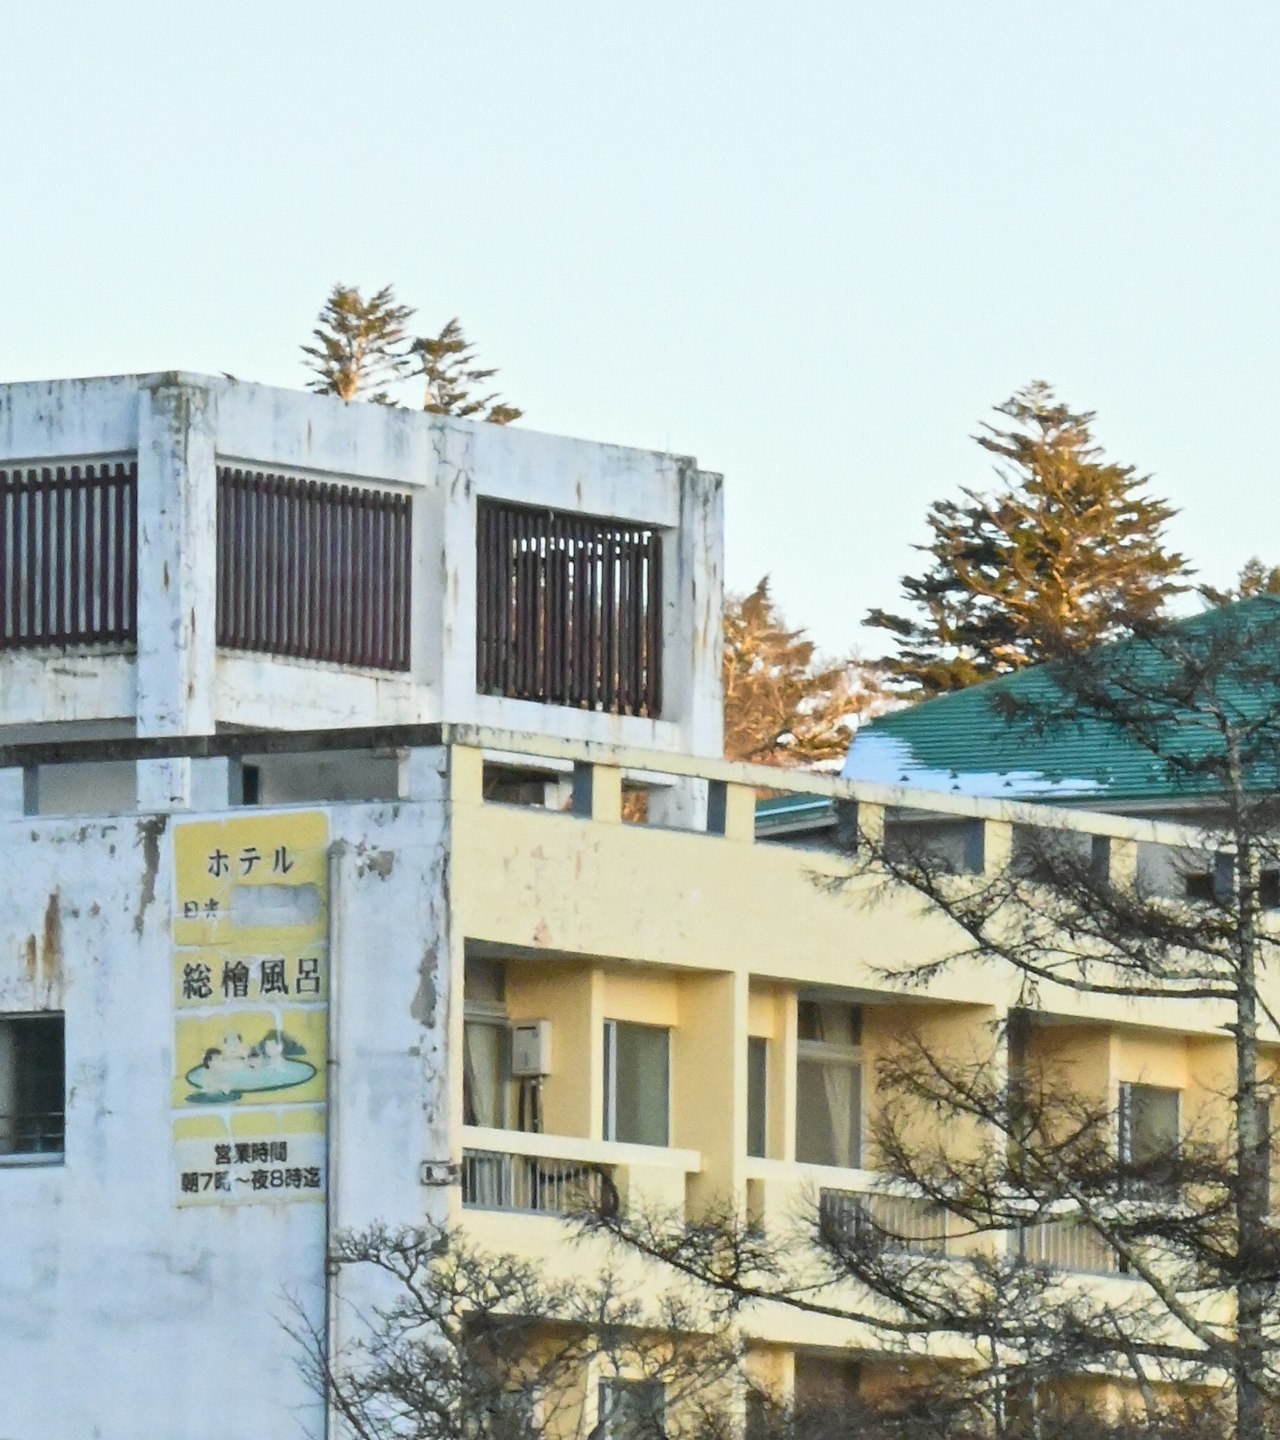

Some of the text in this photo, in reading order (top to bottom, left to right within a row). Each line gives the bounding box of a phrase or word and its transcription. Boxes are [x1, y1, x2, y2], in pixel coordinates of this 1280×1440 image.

[208, 846, 294, 877] ホテル
[182, 957, 321, 1000] 総檜風呂
[214, 1141, 288, 1165] 営業時間
